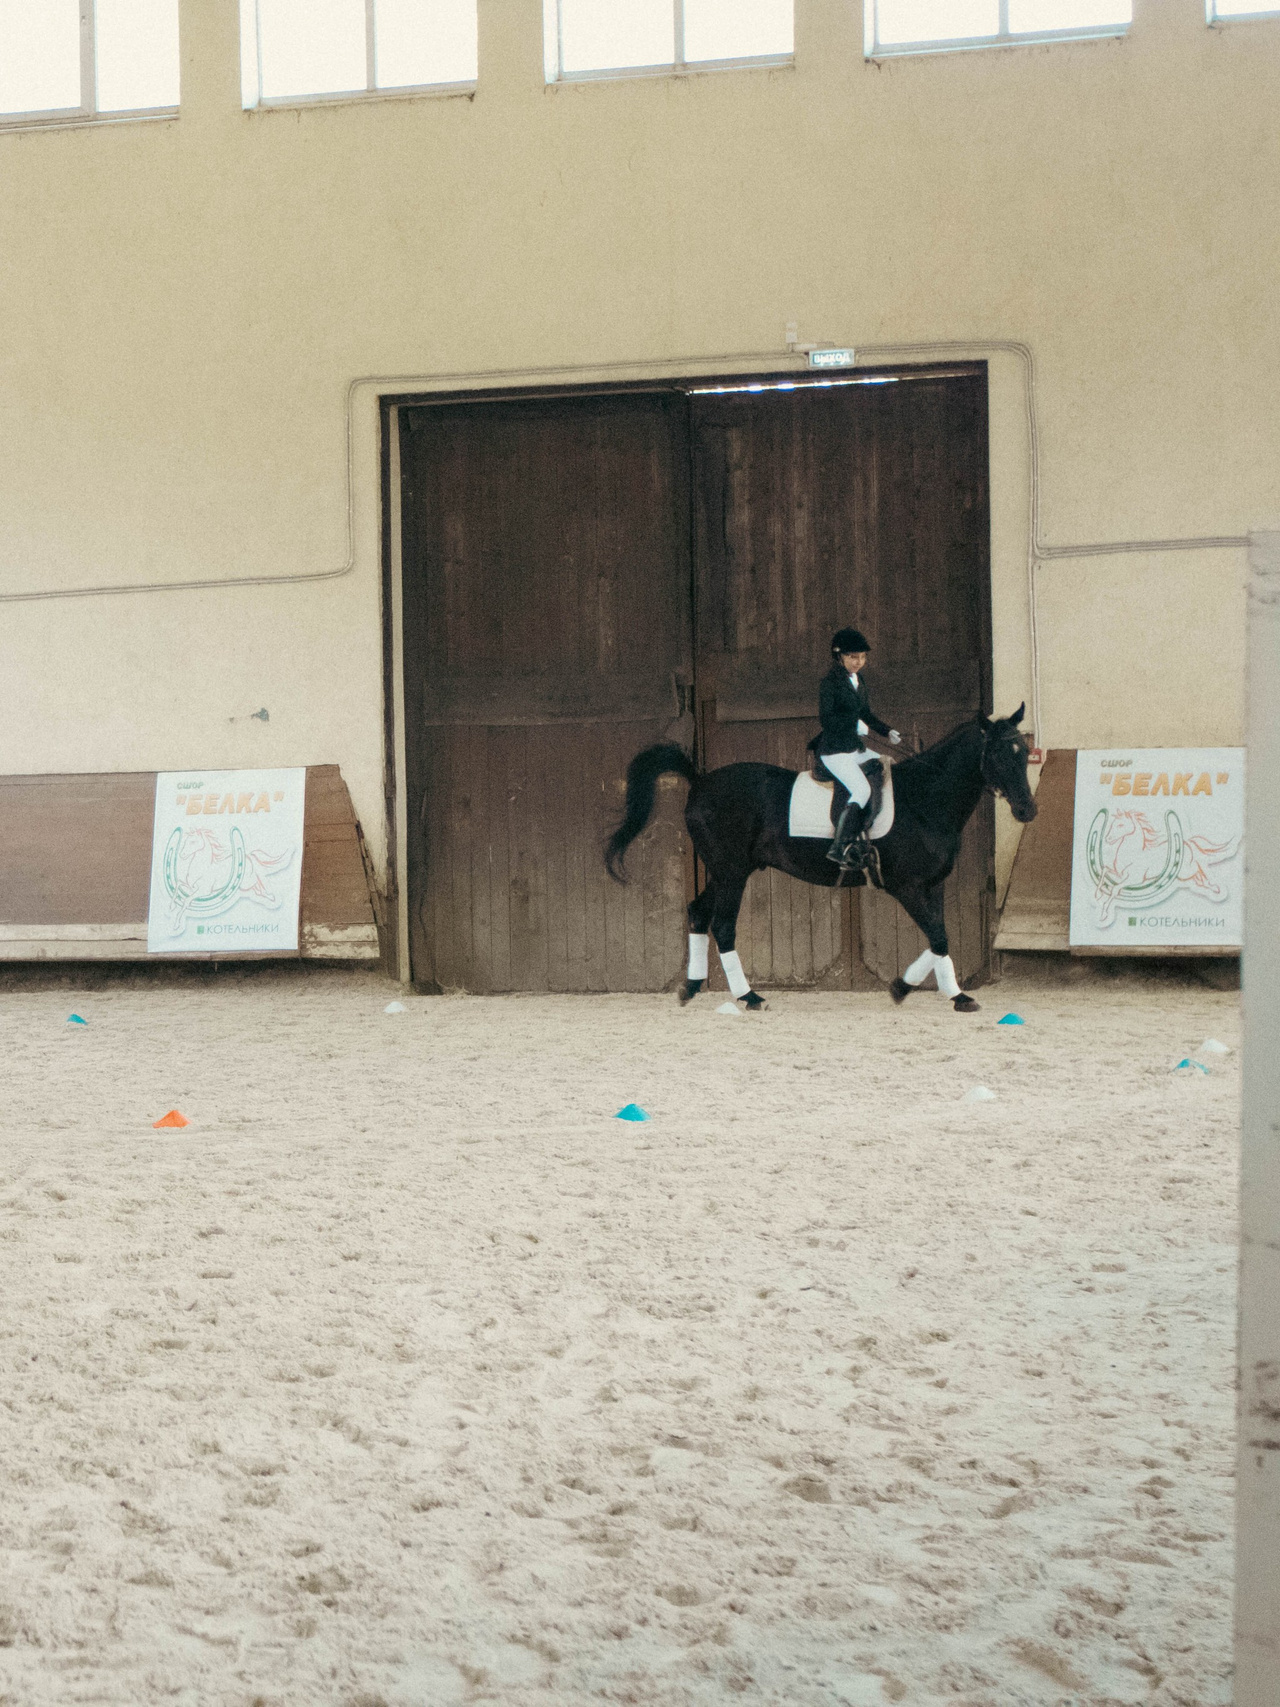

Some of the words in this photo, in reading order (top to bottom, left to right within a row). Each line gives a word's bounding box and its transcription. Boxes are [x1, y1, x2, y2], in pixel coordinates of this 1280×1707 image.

[1100, 772, 1229, 796] "БЕЛКА"
[176, 791, 285, 815] "БЕЛКА"
[207, 925, 279, 934] КОТЕЛЬНИКИ
[1140, 917, 1225, 928] КОТЕЛЬНИКИ
